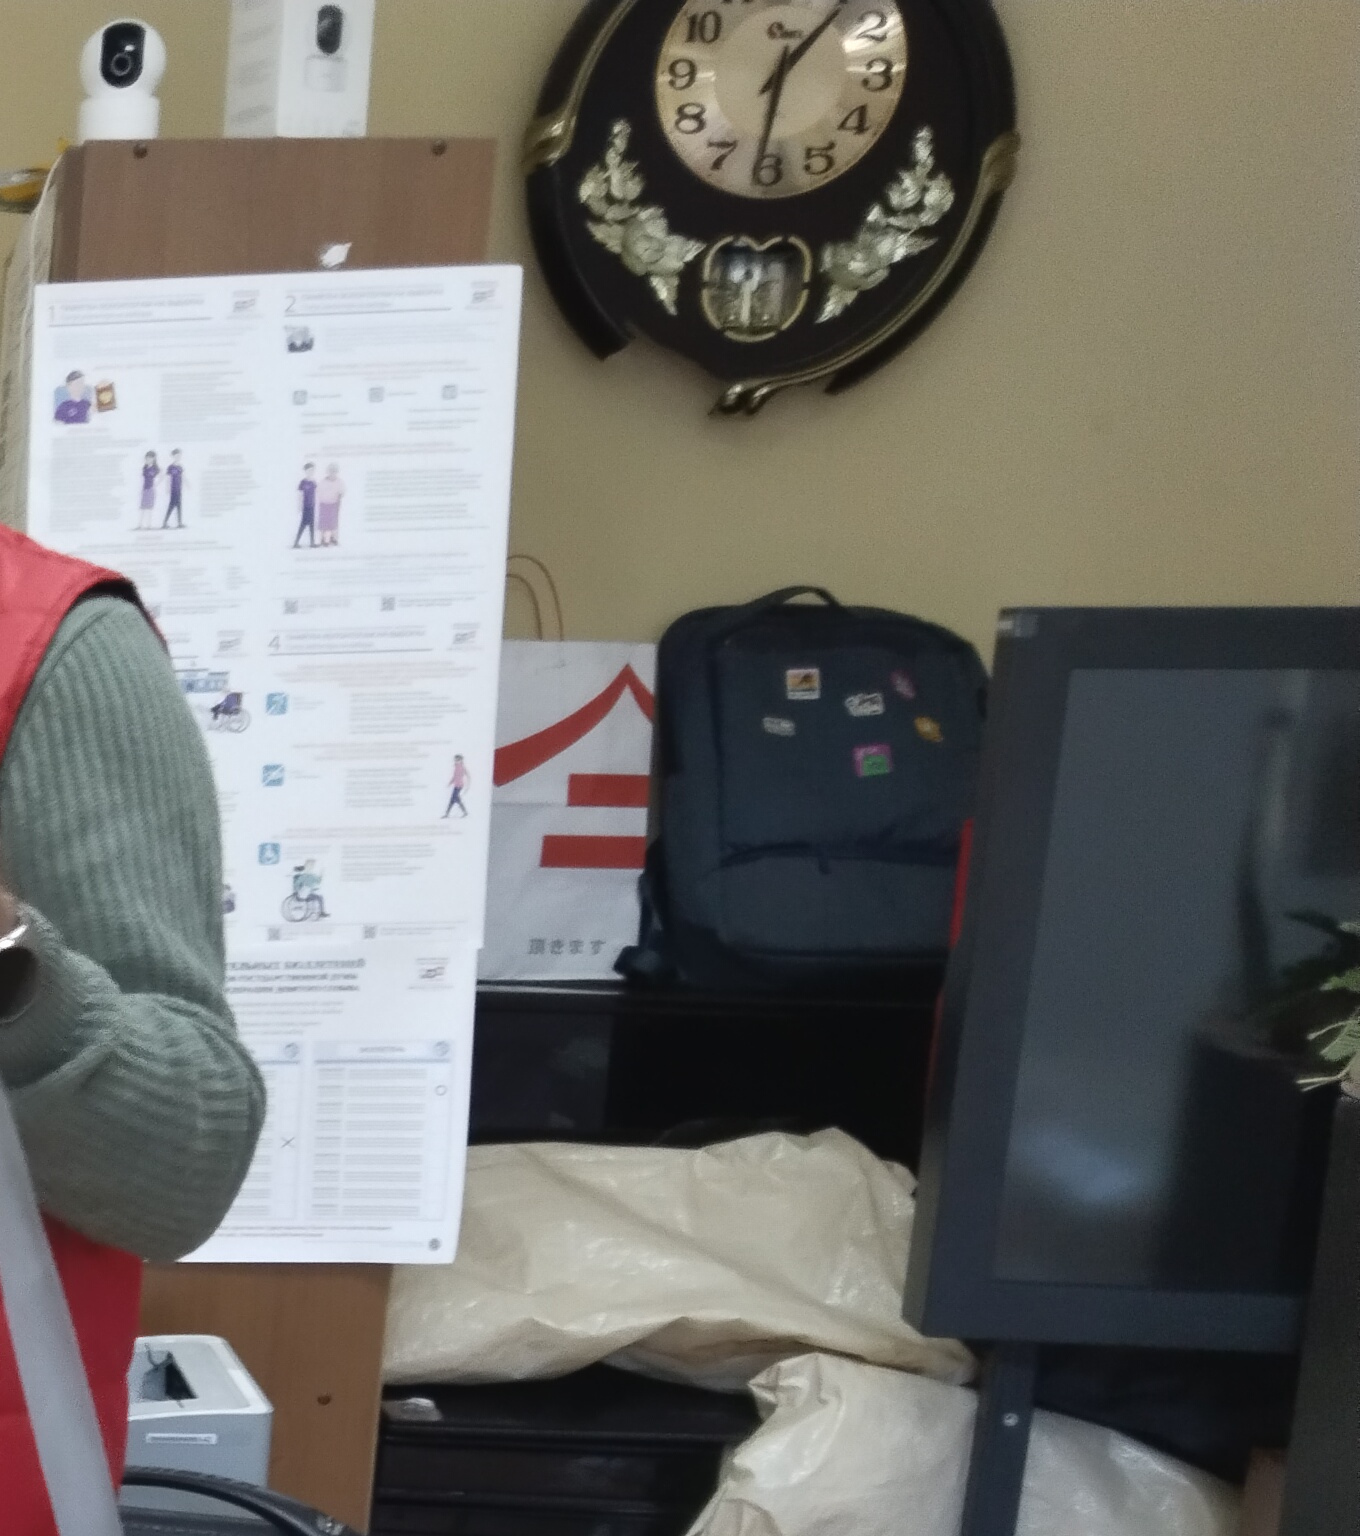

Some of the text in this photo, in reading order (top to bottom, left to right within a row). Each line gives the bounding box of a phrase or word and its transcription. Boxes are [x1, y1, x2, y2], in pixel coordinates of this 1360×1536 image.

[685, 11, 721, 43] 10
[856, 10, 888, 42] 2
[668, 58, 697, 90] 9
[861, 57, 893, 91] 3
[675, 102, 706, 134] 8
[837, 104, 870, 135] 4
[707, 140, 737, 170] 7
[755, 153, 782, 187] 6
[804, 141, 836, 175] 5
[285, 295, 297, 312] 2
[268, 634, 281, 650] 4
